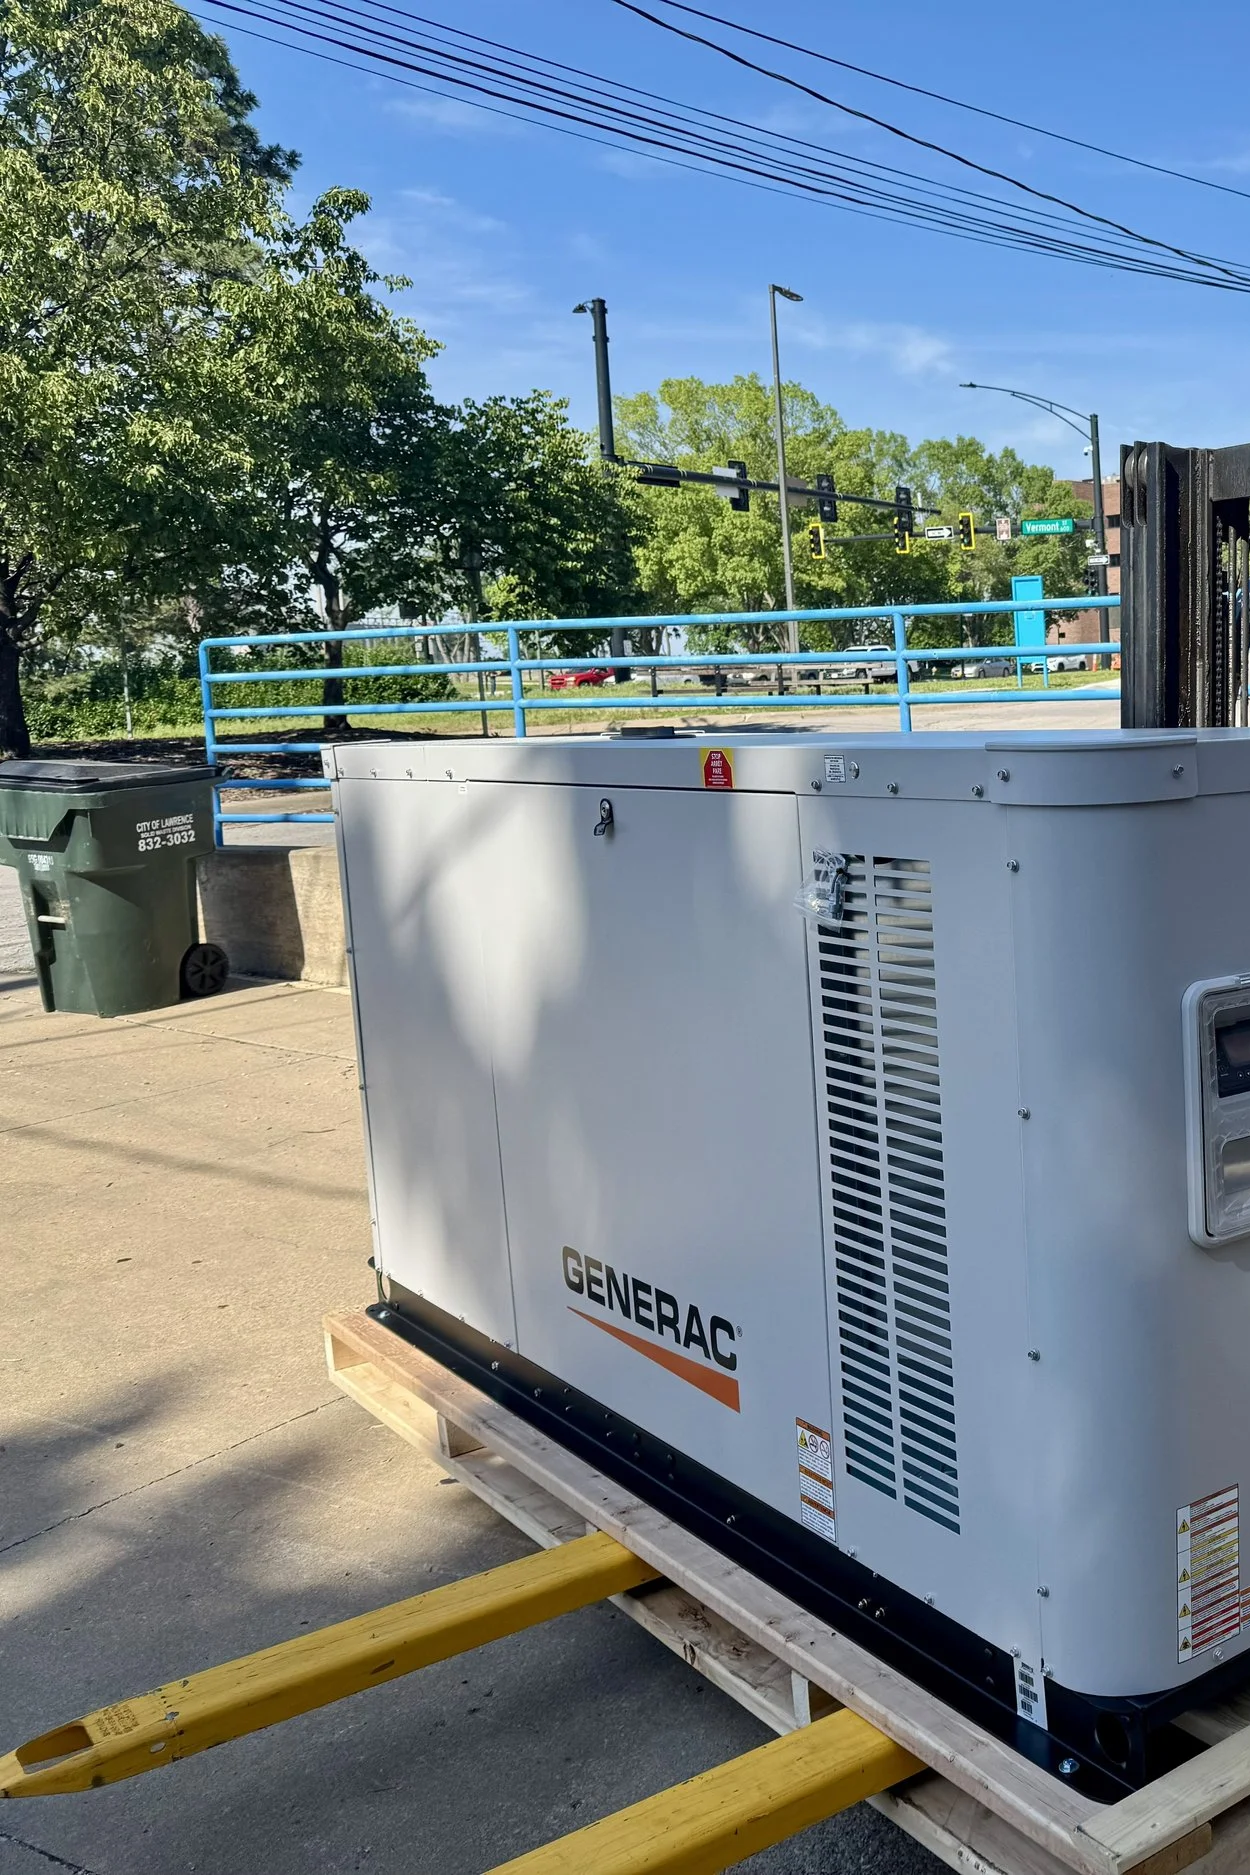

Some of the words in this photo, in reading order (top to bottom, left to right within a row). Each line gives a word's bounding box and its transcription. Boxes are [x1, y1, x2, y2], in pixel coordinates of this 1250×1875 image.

[1025, 521, 1060, 533] Vermont
[136, 821, 151, 833] CITY
[151, 819, 160, 830] OF
[161, 813, 194, 828] LAWRENCE
[138, 829, 196, 852] 832-3032
[562, 1245, 738, 1371] GENERAC
